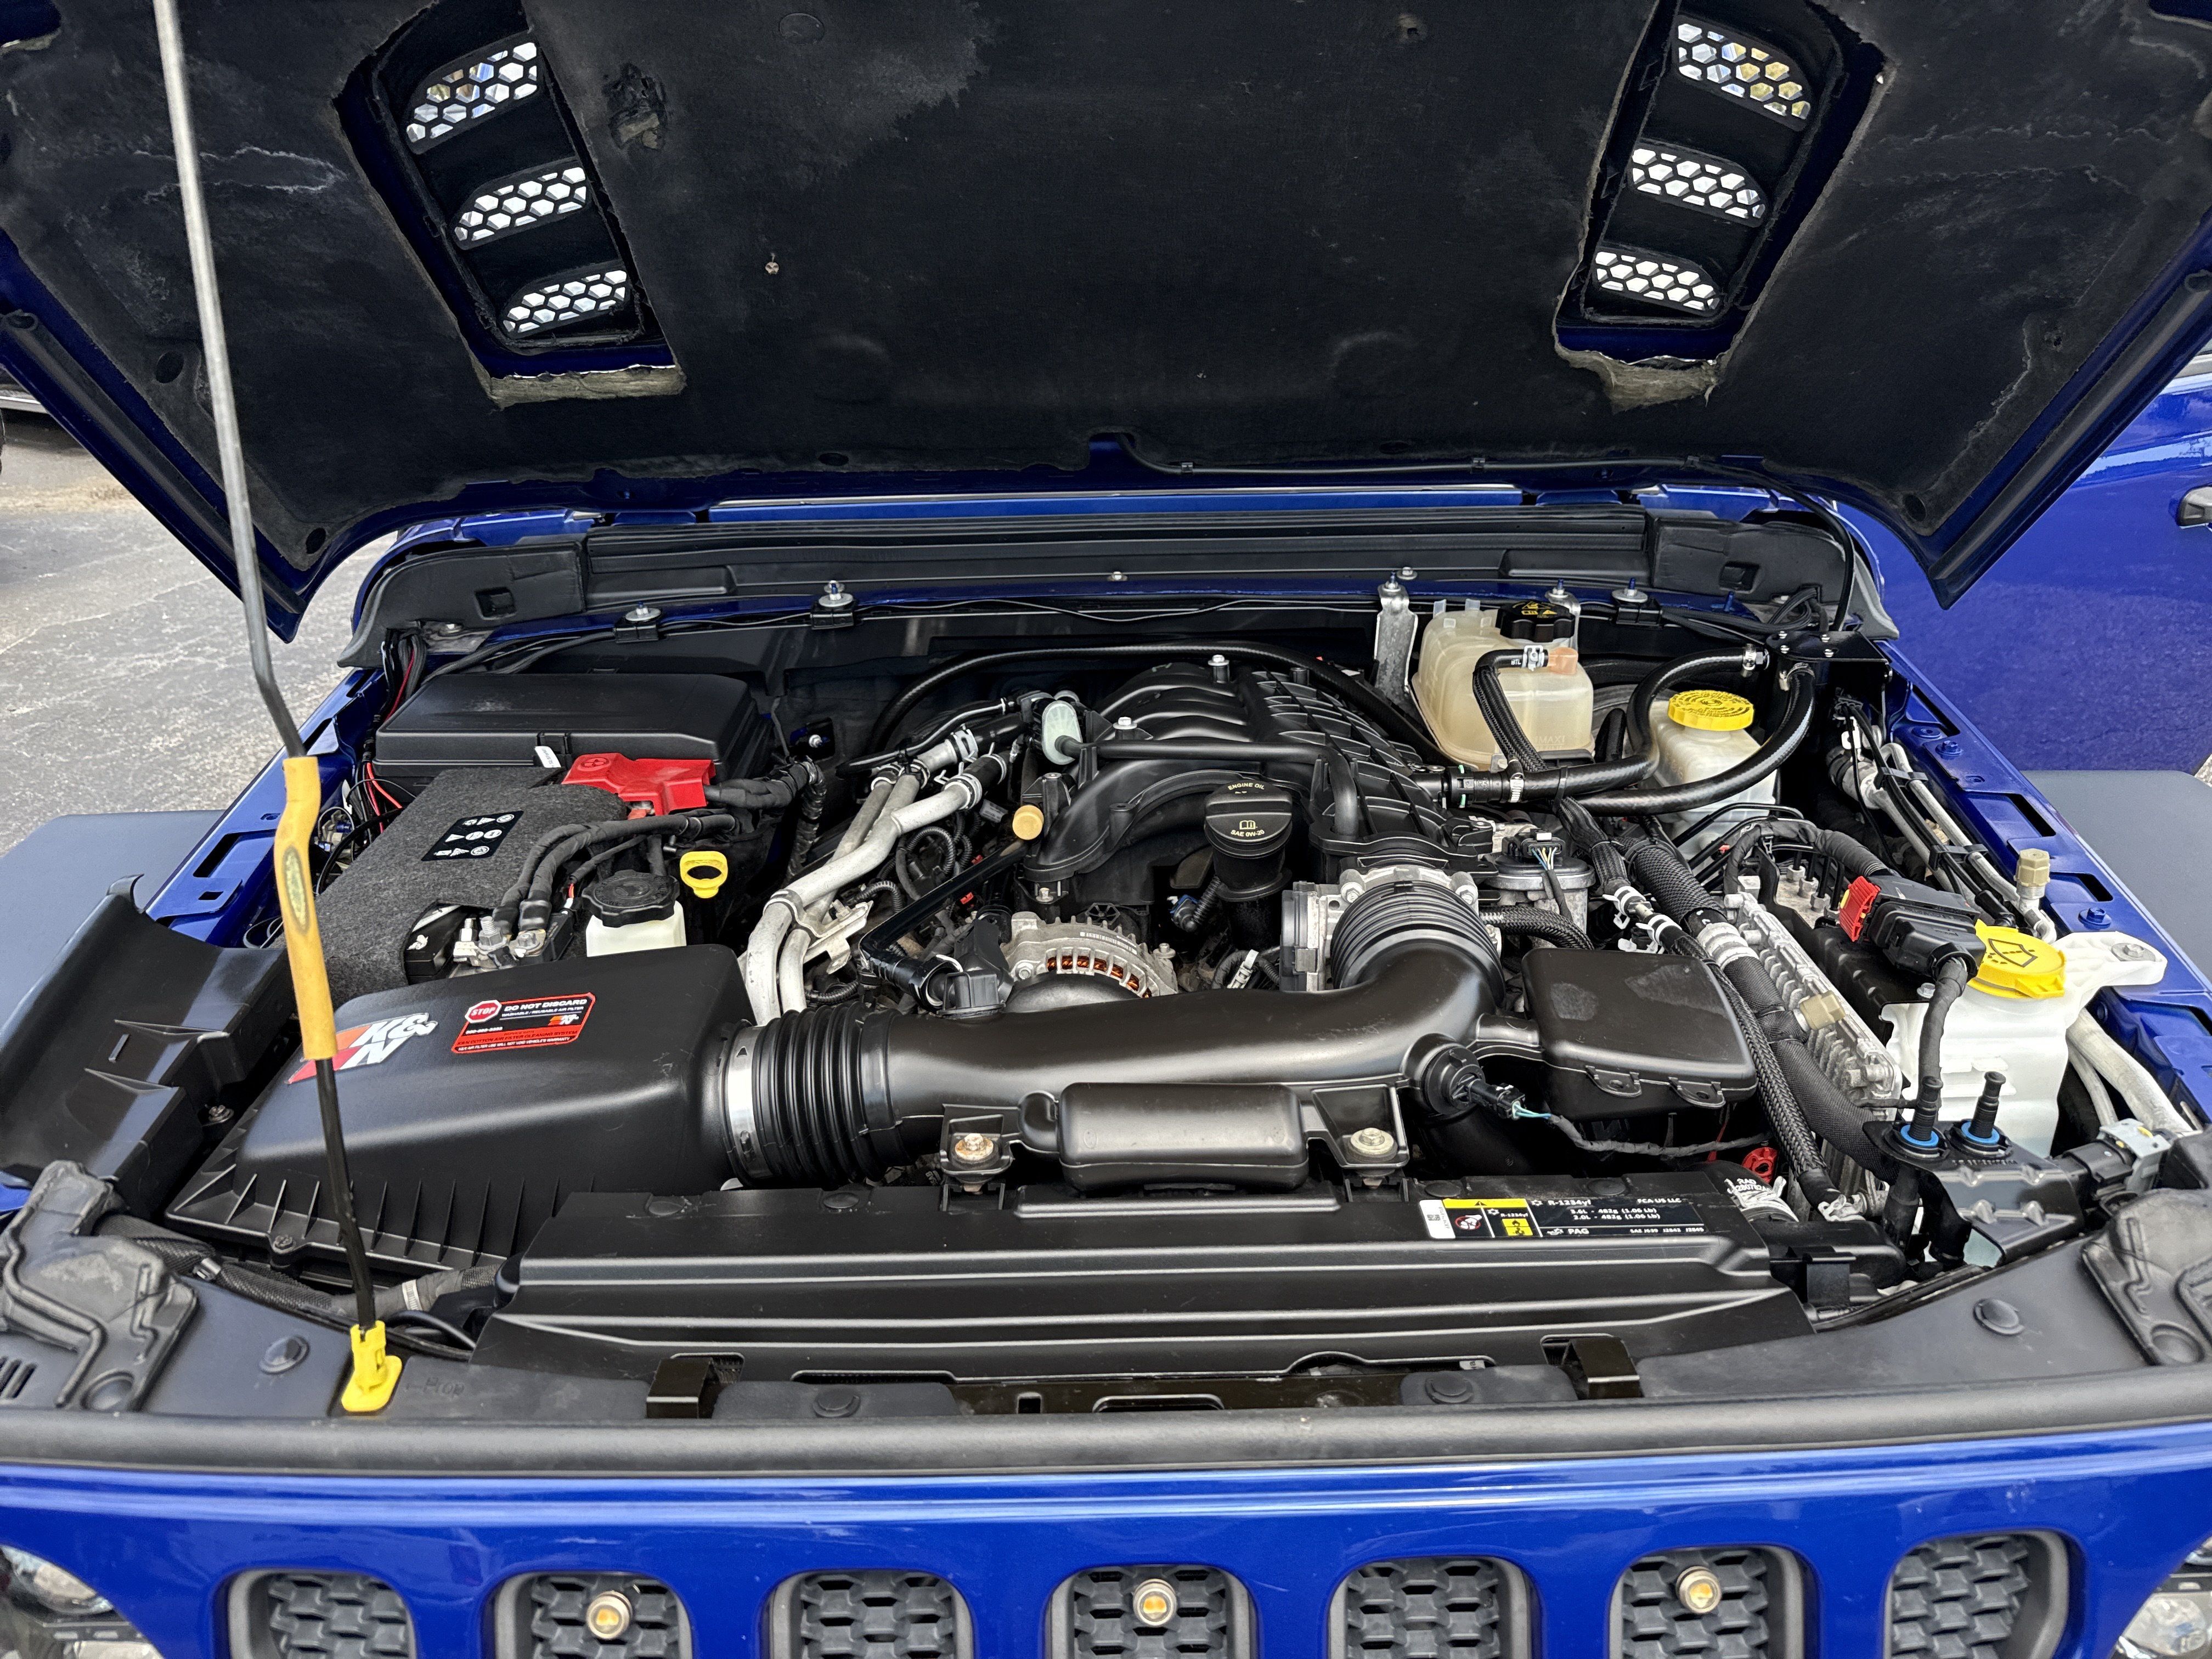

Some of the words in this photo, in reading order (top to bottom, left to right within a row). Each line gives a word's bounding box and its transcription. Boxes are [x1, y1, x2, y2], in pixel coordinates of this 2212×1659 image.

[1227, 782, 1254, 791] ENGINE
[541, 998, 588, 1008] DISCARD
[471, 1006, 495, 1017] STOP
[338, 1013, 437, 1070] K&N
